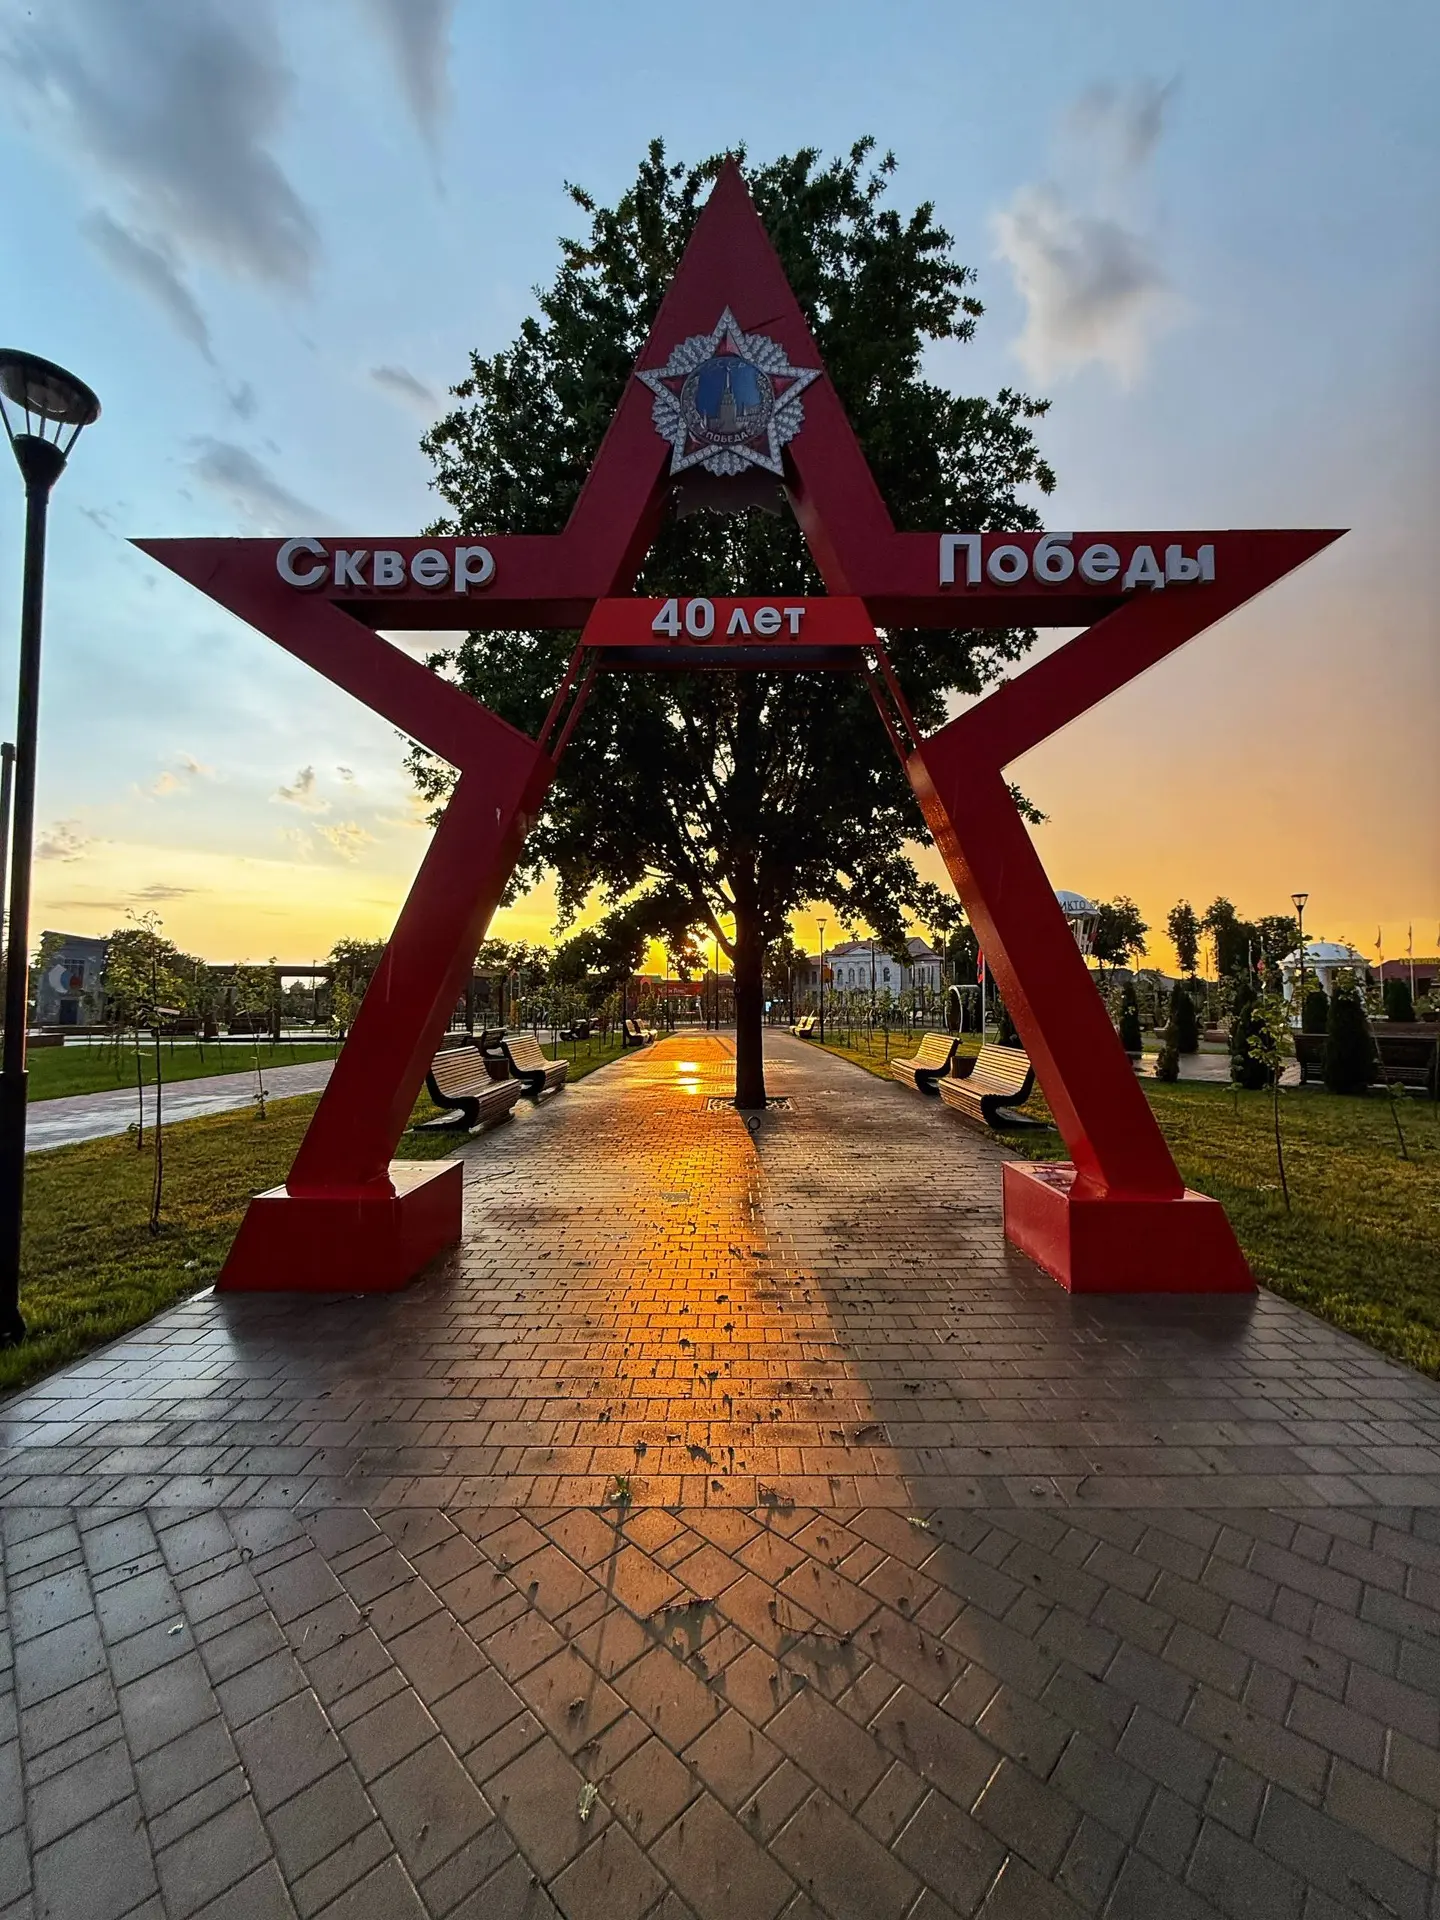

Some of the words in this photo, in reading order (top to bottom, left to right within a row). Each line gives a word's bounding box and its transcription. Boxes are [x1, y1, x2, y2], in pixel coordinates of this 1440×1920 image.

[705, 431, 748, 443] ПОБЕДА
[276, 537, 495, 594] Сквер
[939, 532, 1216, 590] Победы
[651, 597, 715, 638] 40
[726, 606, 806, 638] лет
